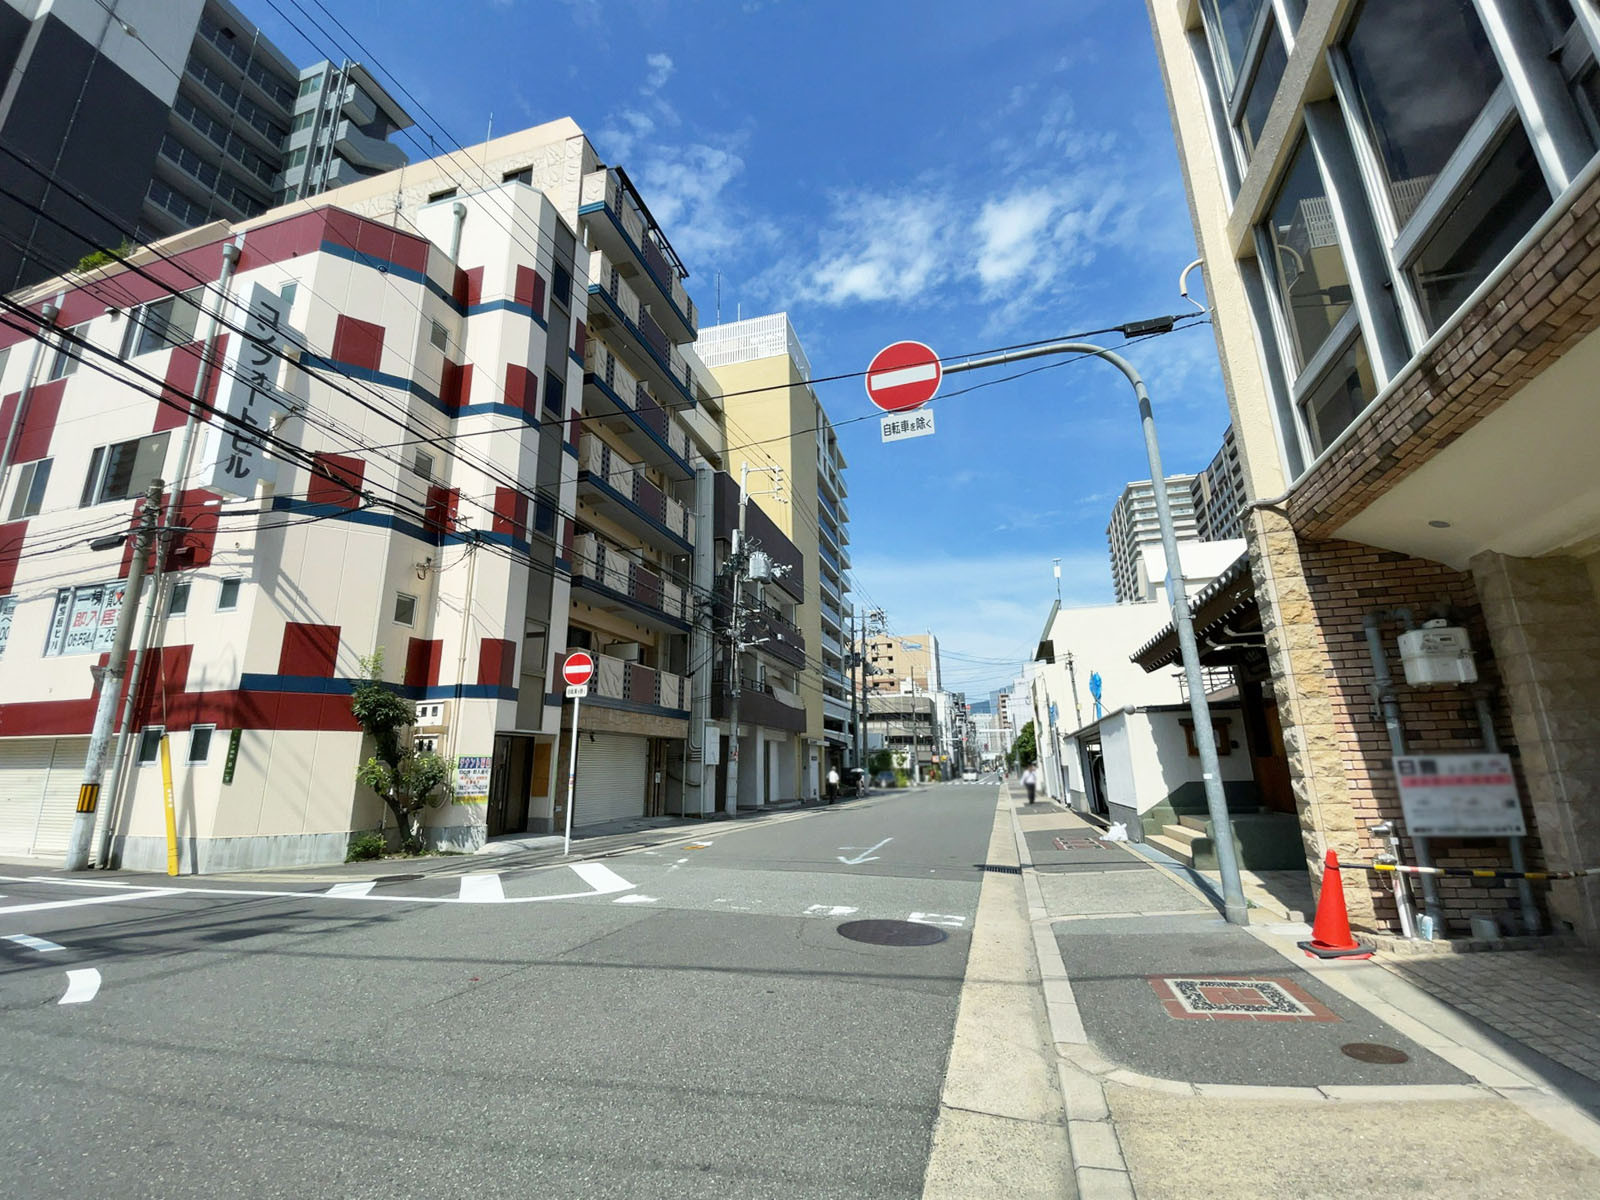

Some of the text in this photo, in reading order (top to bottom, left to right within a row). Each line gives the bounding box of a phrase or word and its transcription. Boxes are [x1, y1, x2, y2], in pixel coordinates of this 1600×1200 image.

[225, 301, 280, 479] コンフォートビル
[884, 417, 932, 437] 自転車を除く
